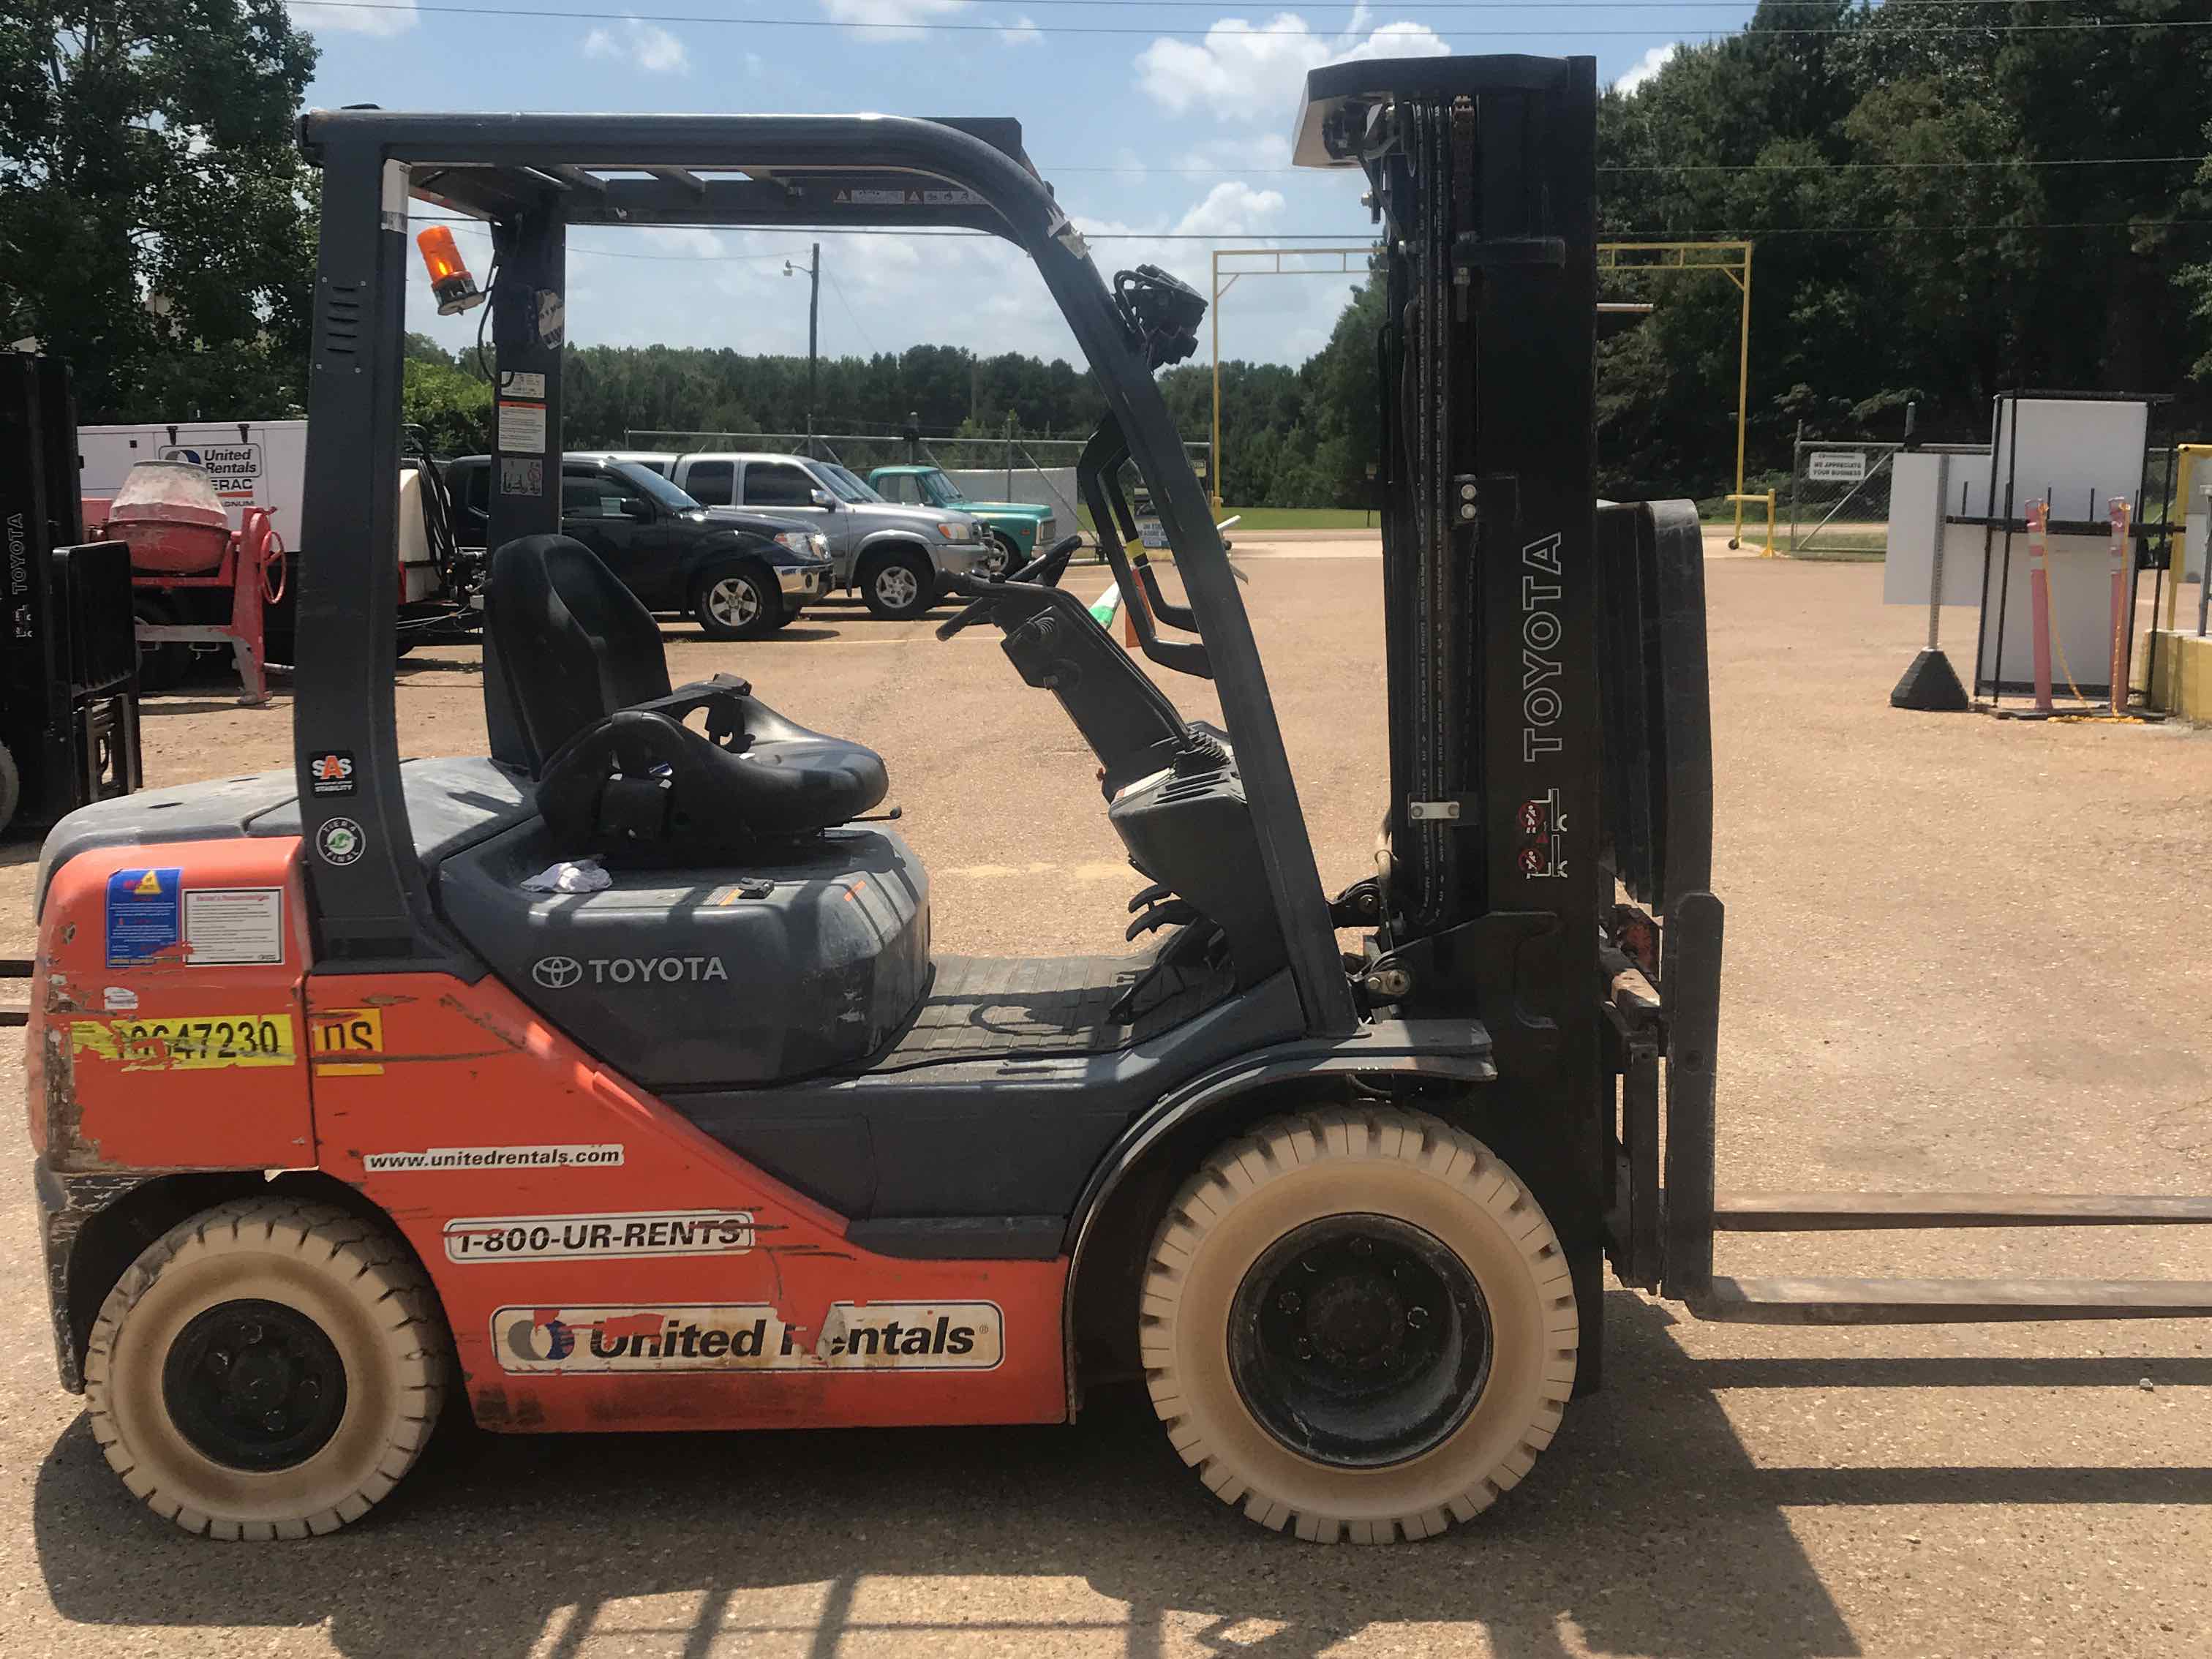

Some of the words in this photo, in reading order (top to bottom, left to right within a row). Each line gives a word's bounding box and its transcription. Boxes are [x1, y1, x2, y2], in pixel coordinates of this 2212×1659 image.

[205, 449, 252, 461] United
[206, 462, 256, 473] Rentals
[211, 478, 253, 491] ERAC
[7, 513, 28, 595] TOYOTA
[1522, 532, 1562, 762] TOYOTA
[312, 755, 353, 780] SAS
[588, 956, 729, 983] TOYOTA
[370, 1148, 620, 1168] www.unitedrentals.com
[459, 1219, 741, 1253] 1-800-UR-RENTS
[590, 1319, 767, 1358] United
[780, 1317, 976, 1357] ntals
